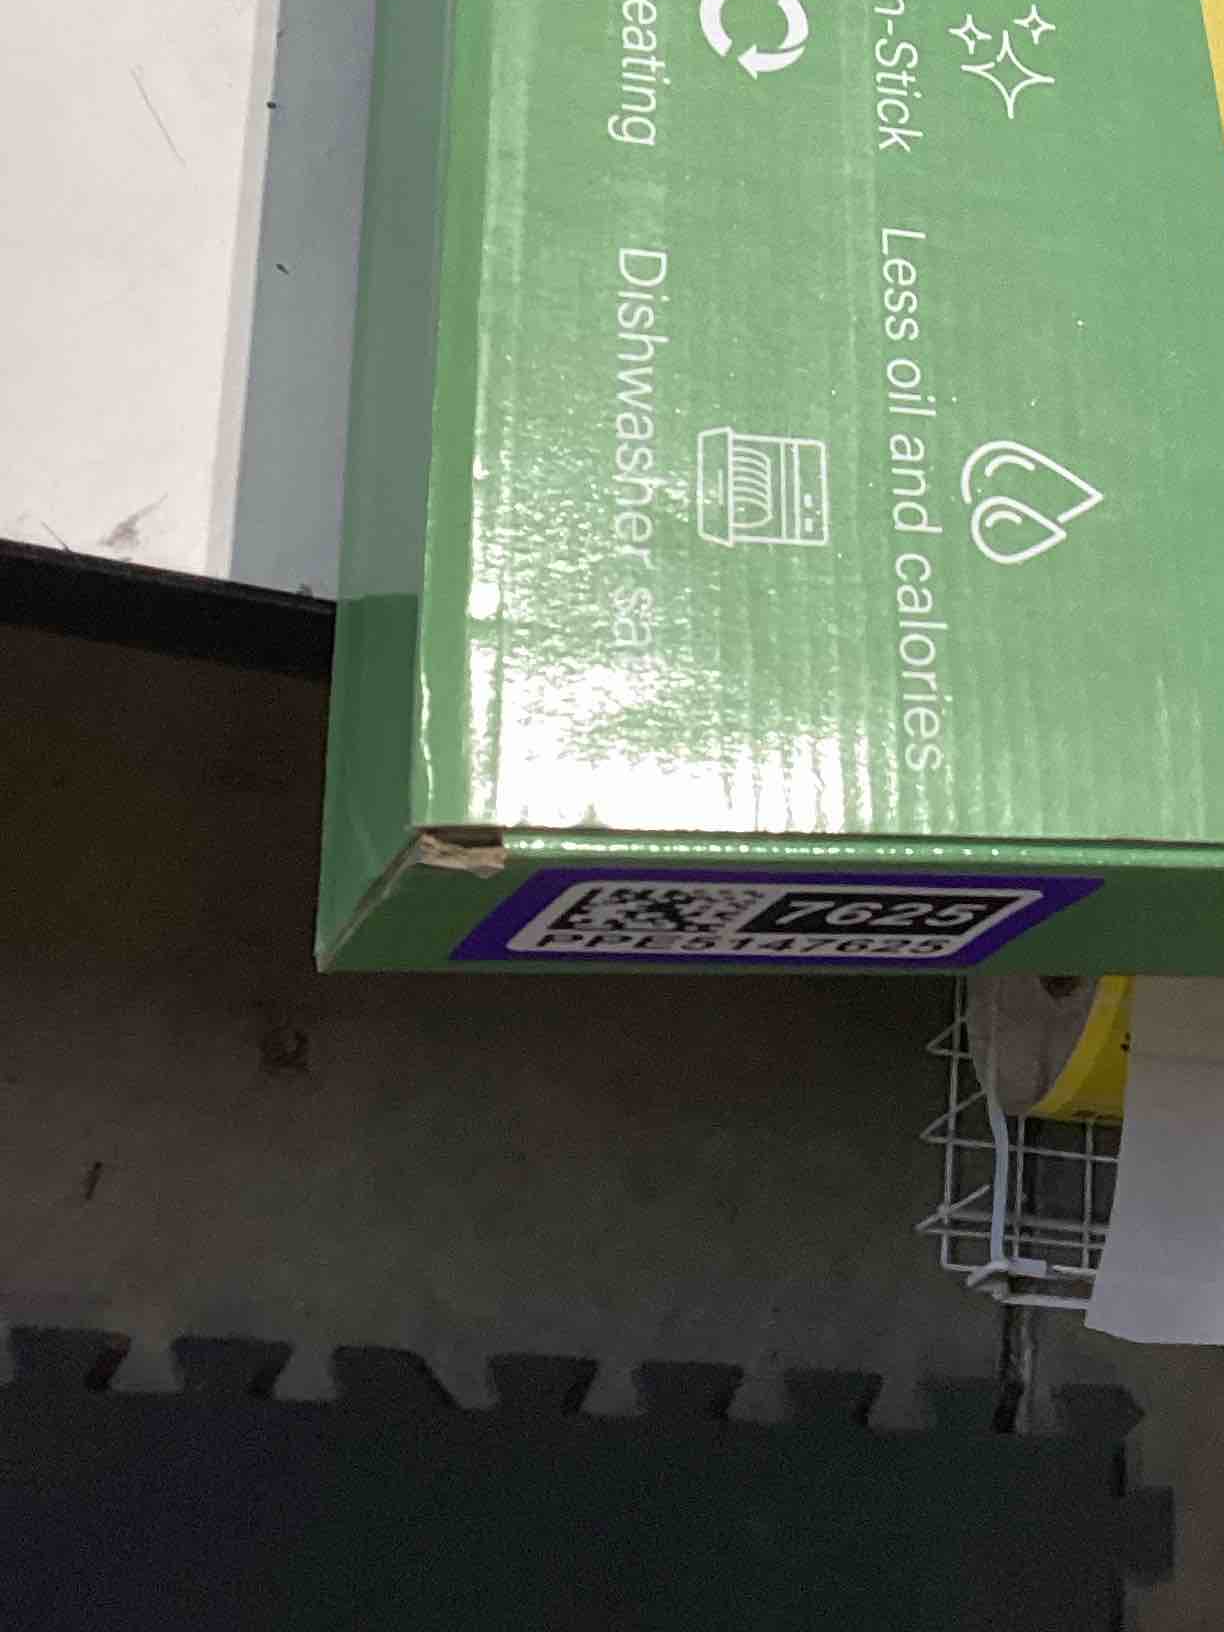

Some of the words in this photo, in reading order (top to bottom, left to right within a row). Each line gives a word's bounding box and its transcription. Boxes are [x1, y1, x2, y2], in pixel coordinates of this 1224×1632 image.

[879, 226, 927, 343] Less
[612, 247, 669, 570] Dishwasher
[884, 356, 938, 417] oil
[888, 433, 943, 534] and
[895, 552, 953, 772] calories
[535, 932, 952, 956] PPE5147625
[772, 900, 990, 928] 7625
